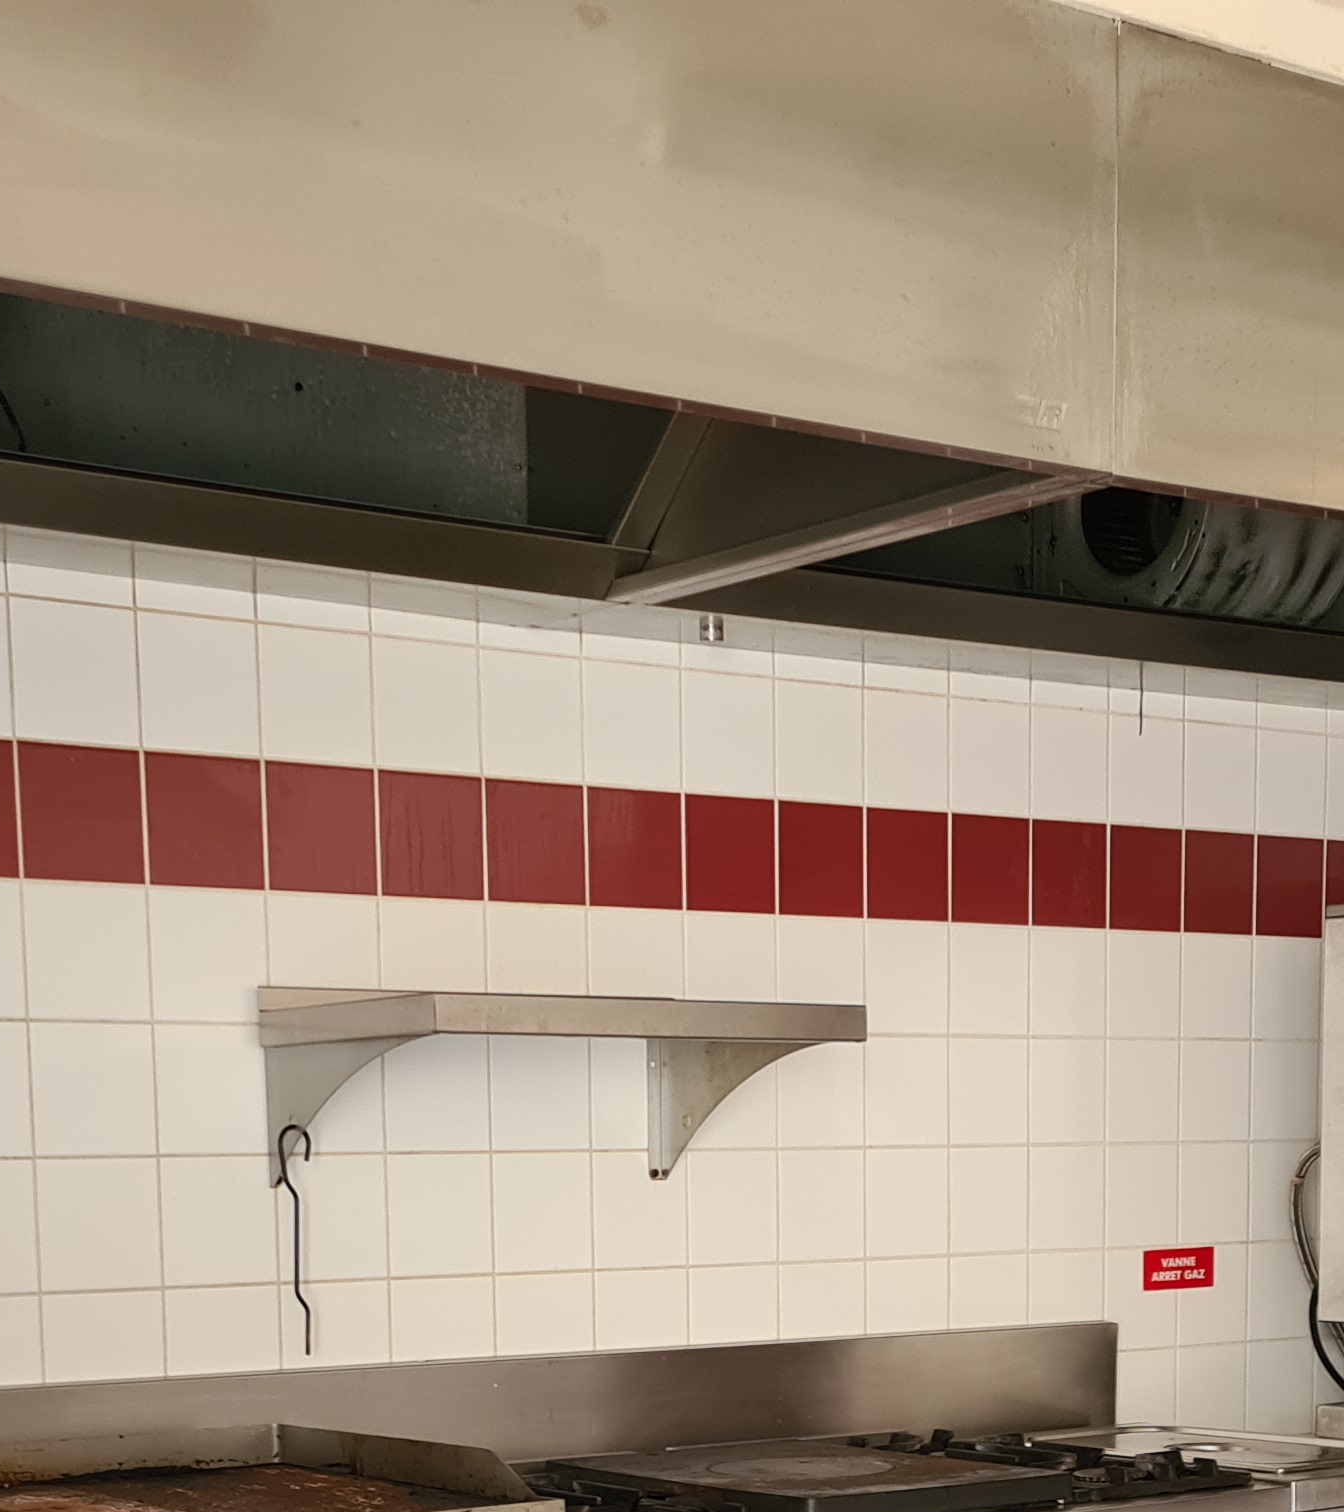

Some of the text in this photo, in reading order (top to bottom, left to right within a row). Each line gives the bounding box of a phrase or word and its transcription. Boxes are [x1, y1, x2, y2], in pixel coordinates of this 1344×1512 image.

[1160, 1256, 1196, 1268] VANNE
[1151, 1269, 1206, 1282] ARRET GAZ
